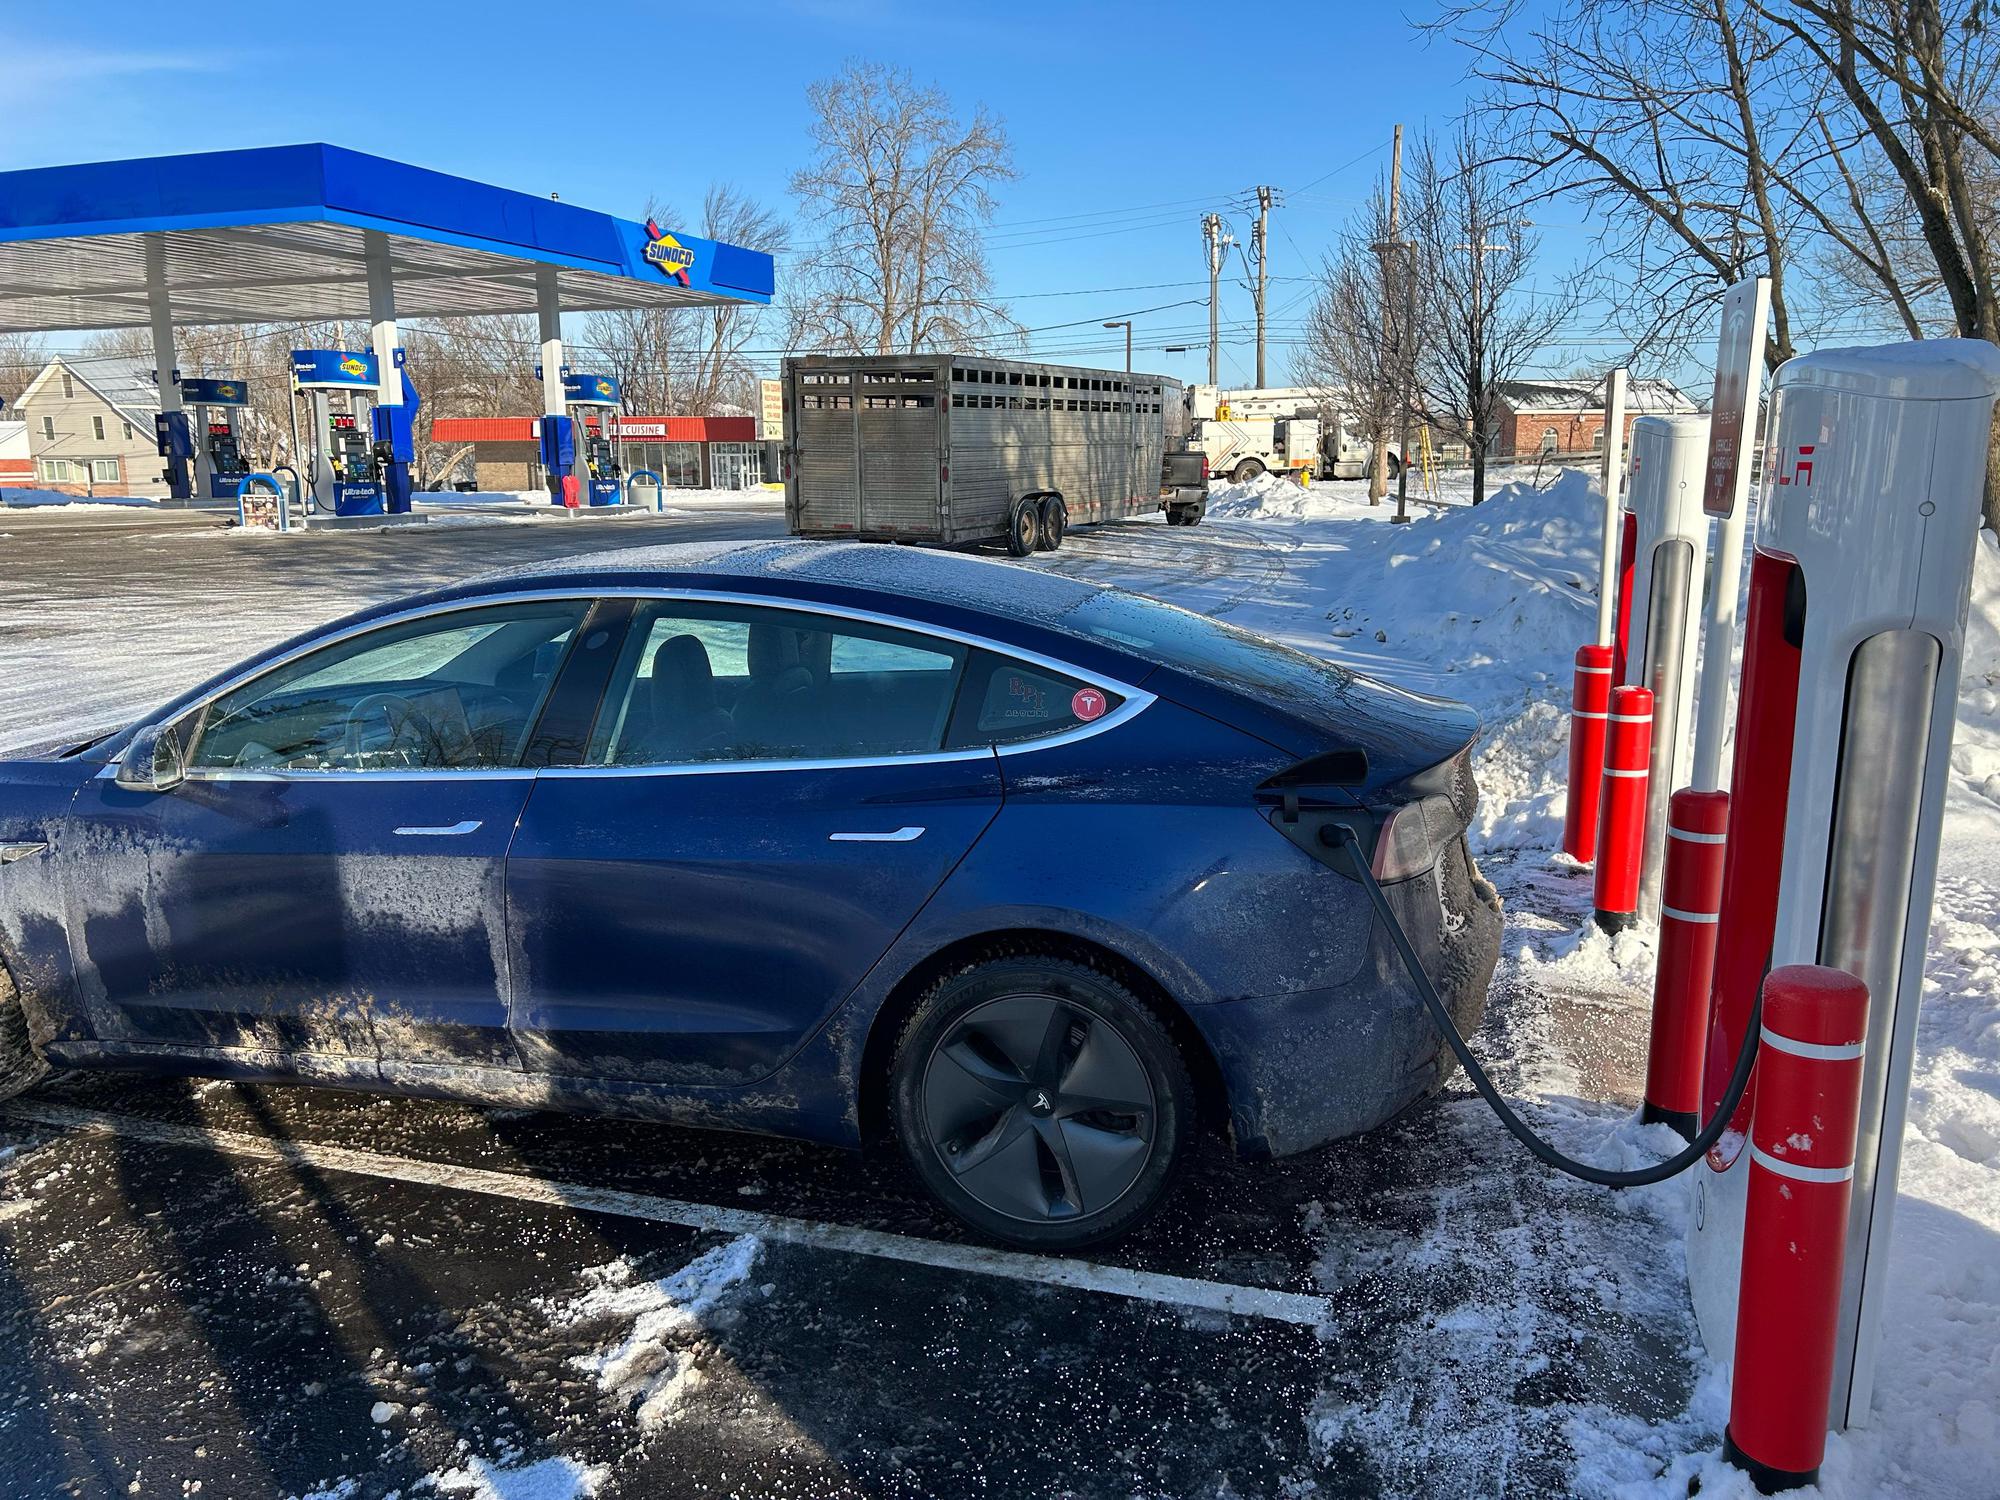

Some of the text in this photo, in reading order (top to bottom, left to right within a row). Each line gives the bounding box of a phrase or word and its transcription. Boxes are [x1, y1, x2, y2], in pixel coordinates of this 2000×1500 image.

[649, 242, 692, 265] SUNOCO
[397, 353, 402, 361] 6
[341, 364, 366, 372] SUNOCO
[626, 426, 660, 434] CUISINE
